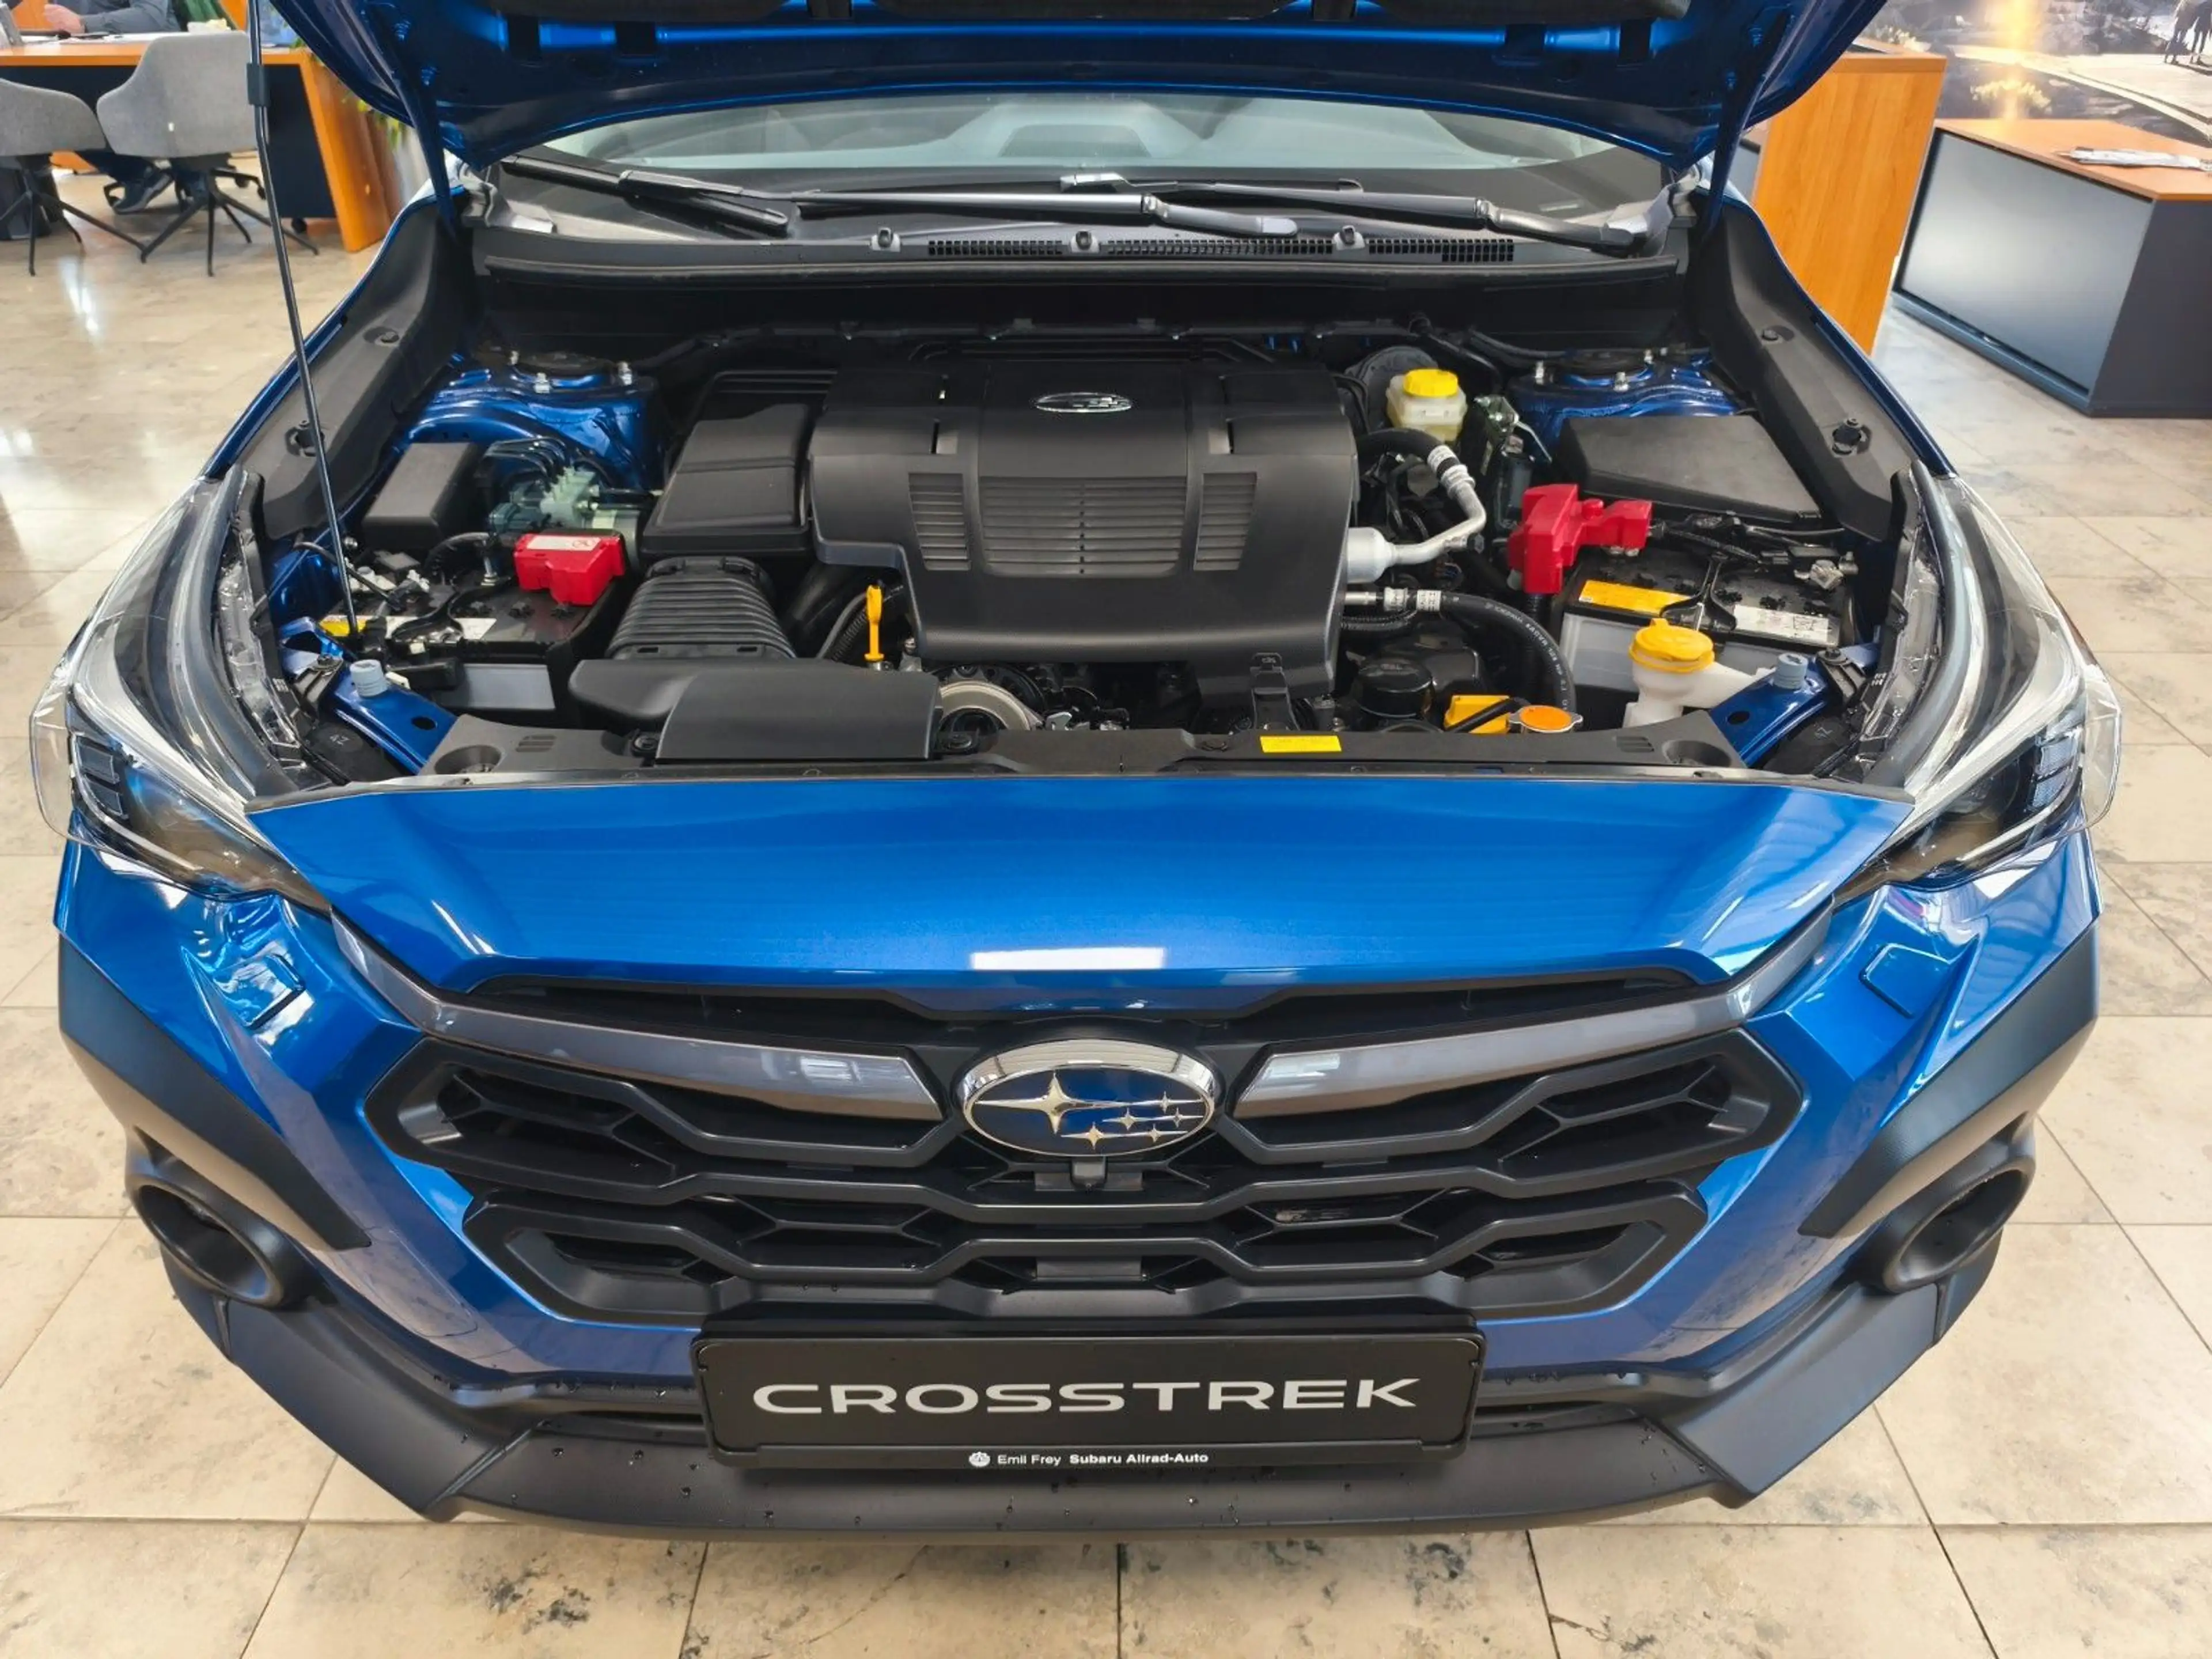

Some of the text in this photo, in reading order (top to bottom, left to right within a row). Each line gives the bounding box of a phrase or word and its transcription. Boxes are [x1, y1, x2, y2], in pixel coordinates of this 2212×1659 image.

[753, 1378, 1420, 1414] CROSSTREK
[997, 1452, 1209, 1467] Emil Frey Subaru Allrad-Auto
